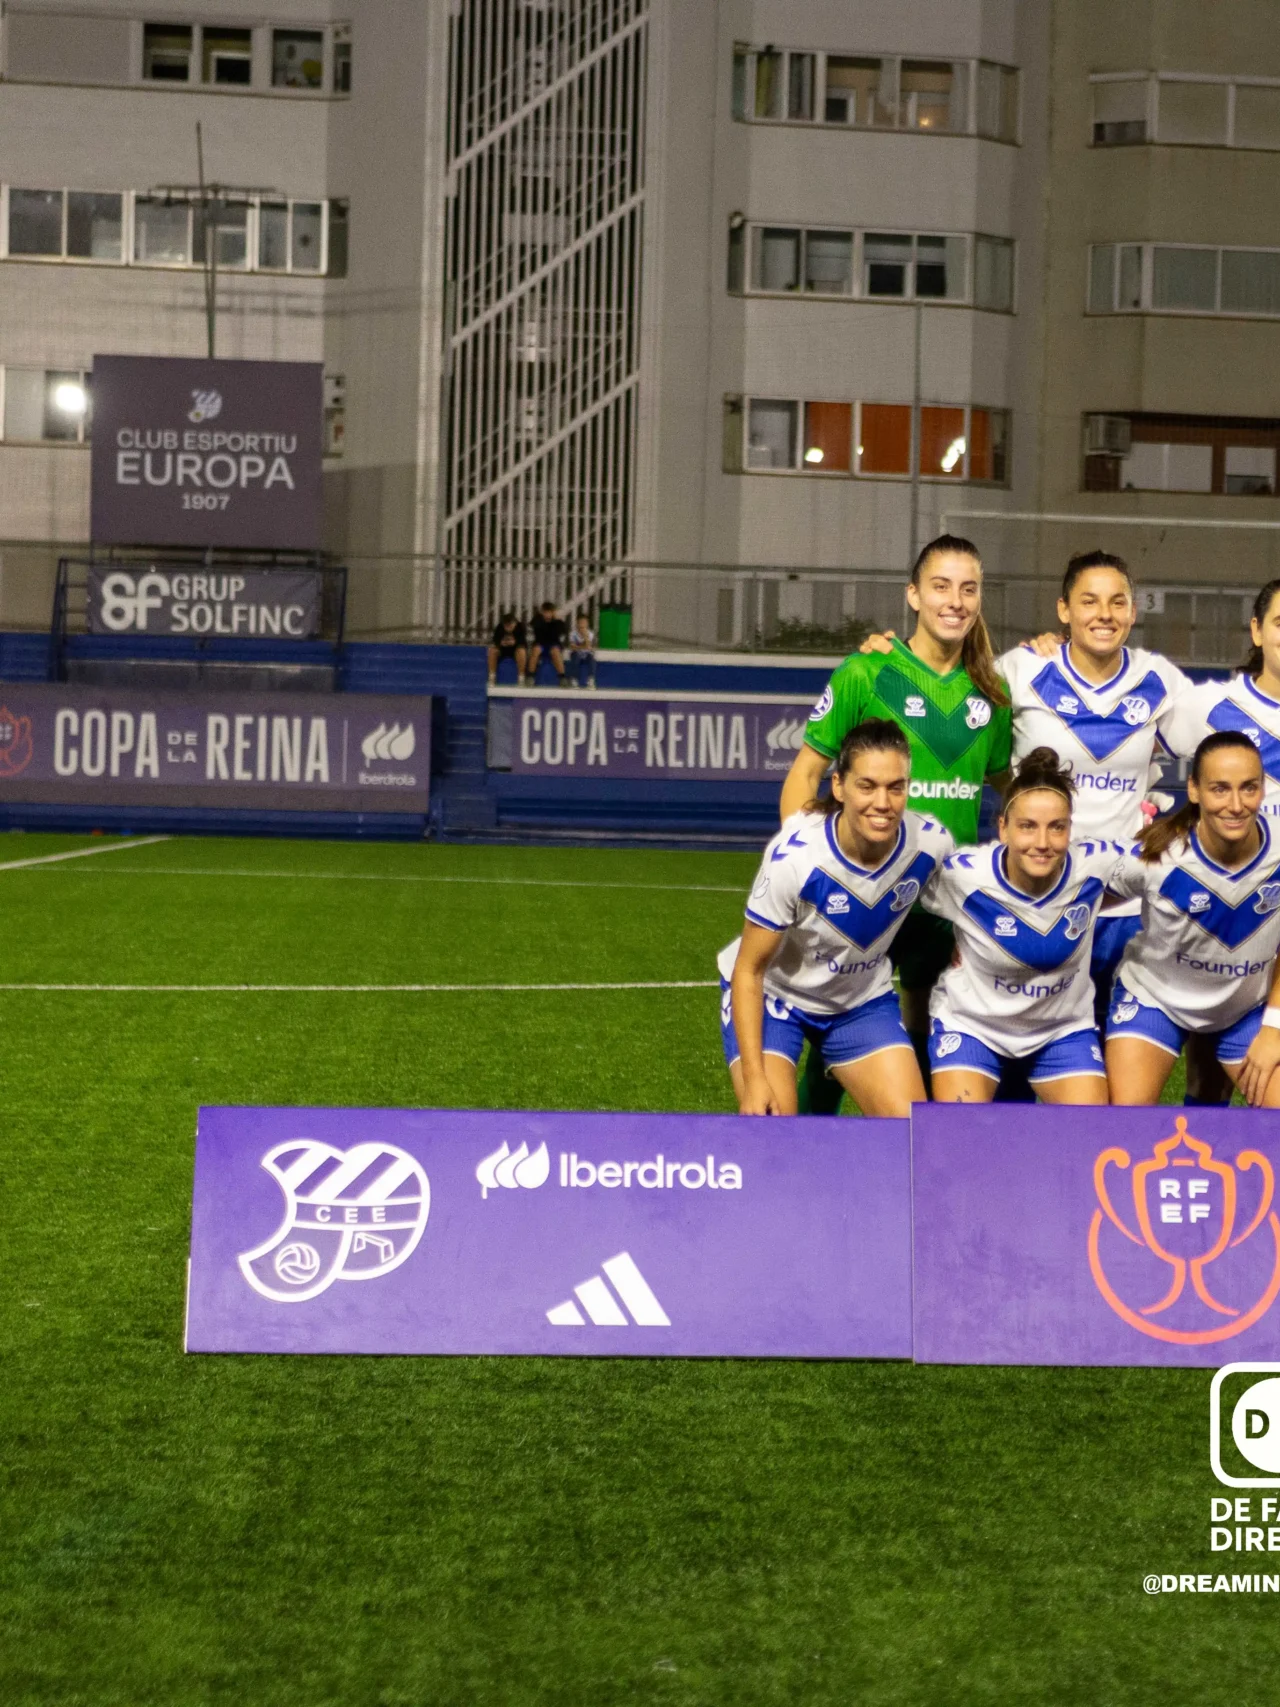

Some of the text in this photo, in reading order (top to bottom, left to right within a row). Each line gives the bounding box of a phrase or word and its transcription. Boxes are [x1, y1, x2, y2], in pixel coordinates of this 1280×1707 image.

[116, 428, 298, 454] CLUB ESPORTIU
[116, 451, 296, 490] EUROPA
[181, 493, 231, 511] 1907
[171, 575, 245, 601] GRUP
[1145, 594, 1156, 610] 3
[170, 602, 305, 635] SOLFINC
[53, 709, 160, 778] COPA
[167, 732, 197, 746] DE
[206, 715, 330, 783] REINA
[520, 708, 748, 770] COPA DE LA REINA
[167, 749, 197, 763] LA
[359, 772, 416, 786] Iberdrola
[909, 777, 980, 799] ounder
[1176, 952, 1268, 977] Founder
[558, 1153, 743, 1190] Iberdrola
